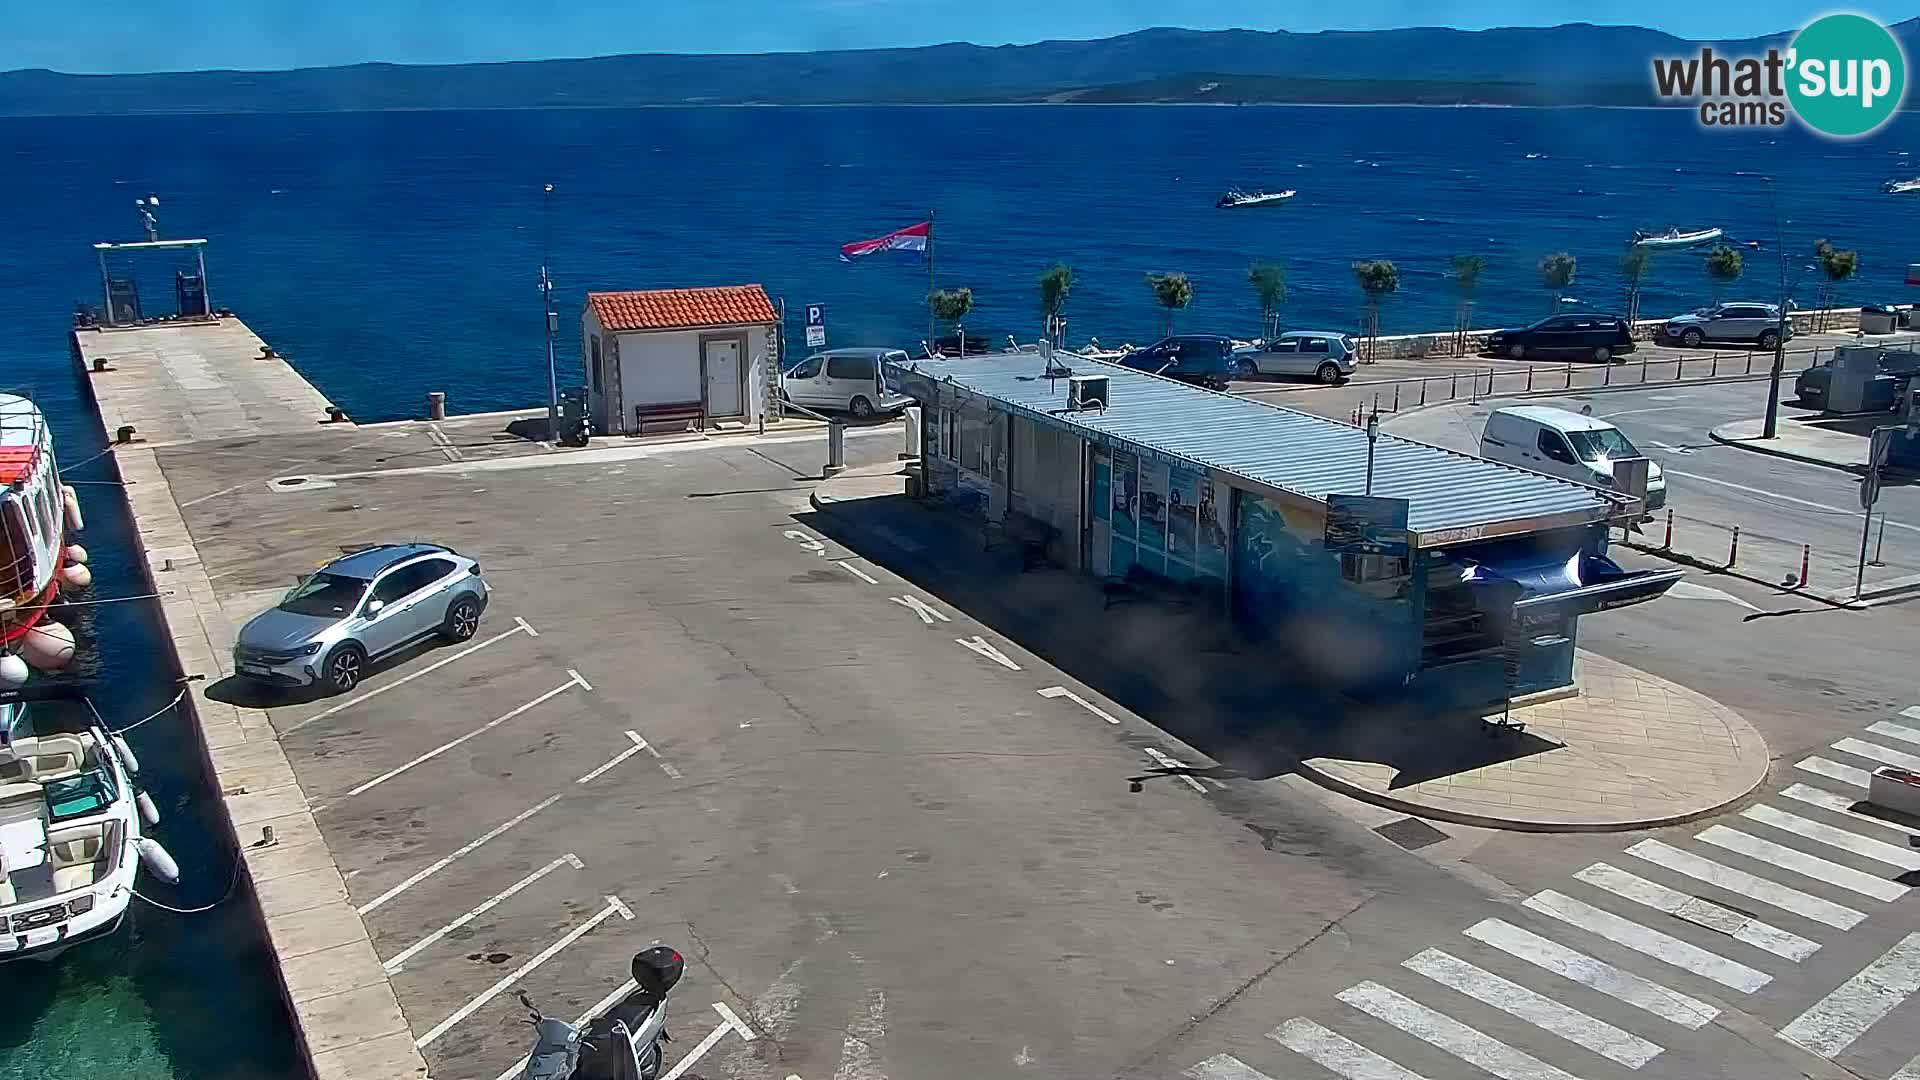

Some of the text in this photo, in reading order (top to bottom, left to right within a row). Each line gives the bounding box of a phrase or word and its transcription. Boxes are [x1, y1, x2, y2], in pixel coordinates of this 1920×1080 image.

[809, 307, 820, 324] P
[1156, 451, 1178, 466] TICKET
[1181, 459, 1206, 476] OFFICE
